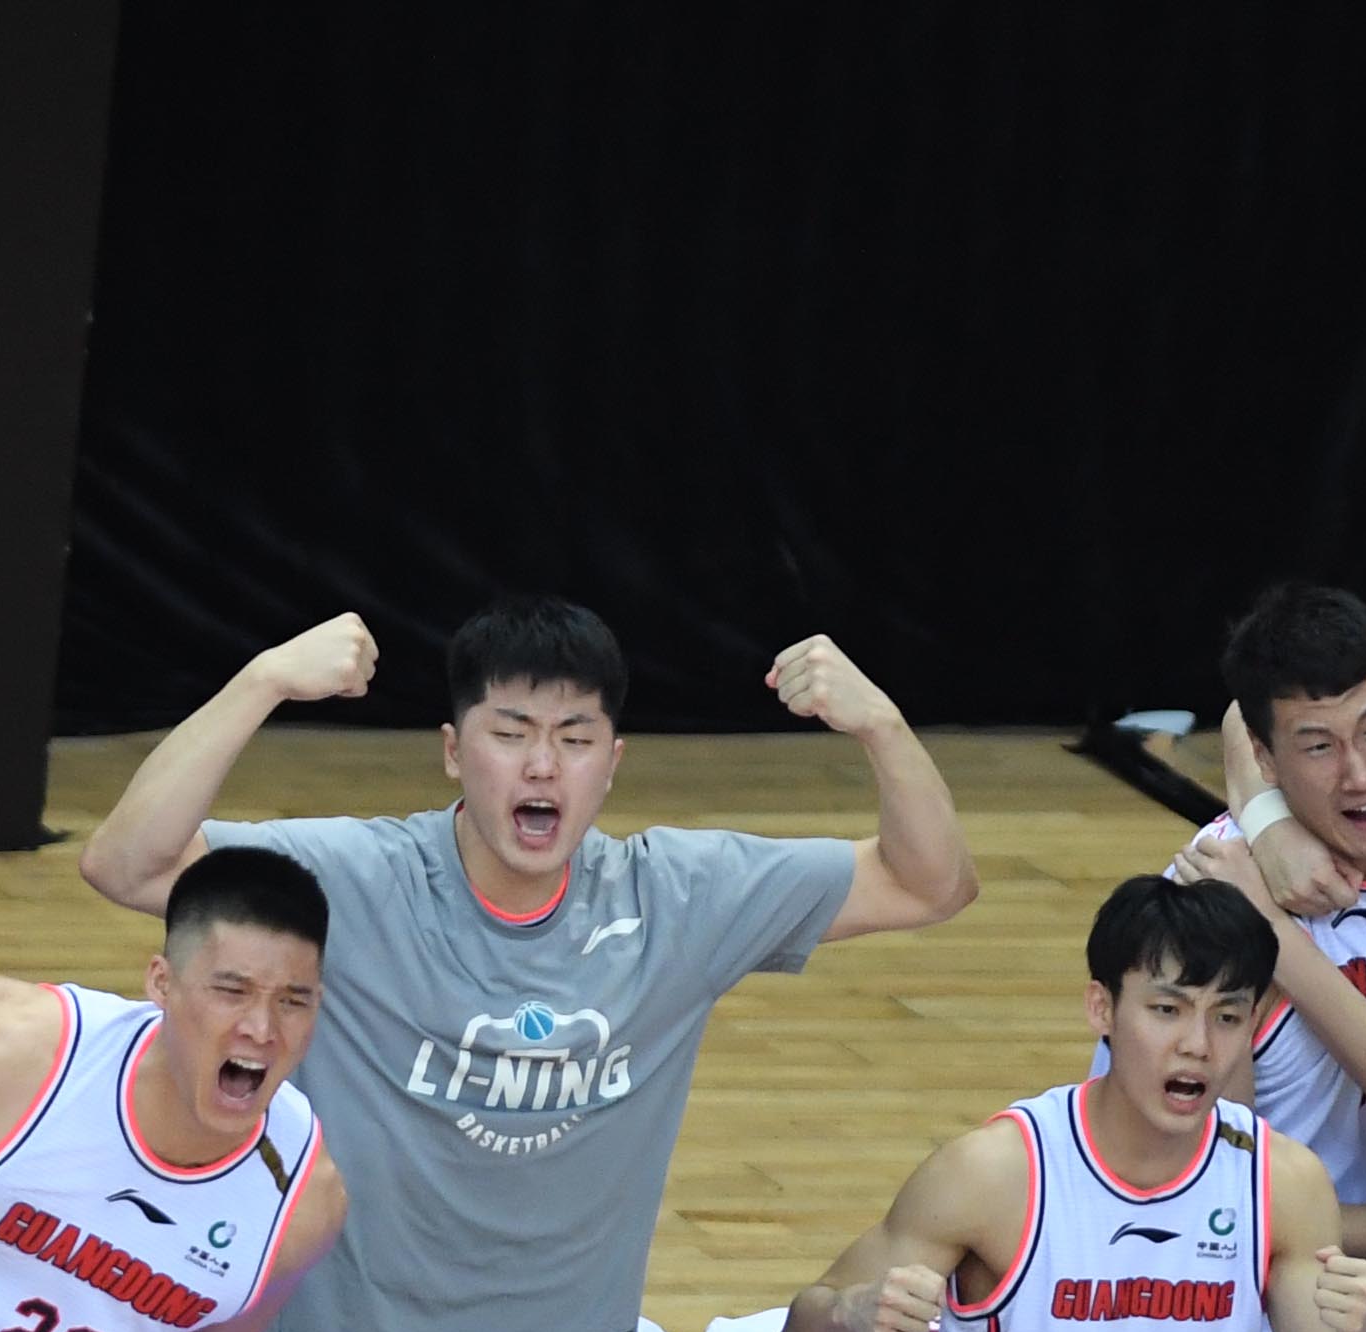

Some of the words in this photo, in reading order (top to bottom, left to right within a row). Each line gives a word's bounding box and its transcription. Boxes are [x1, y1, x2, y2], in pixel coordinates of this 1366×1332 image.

[407, 1039, 632, 1110] LI-NING
[456, 1112, 583, 1155] BASKETBALL
[1051, 1277, 1235, 1322] GUANGDONG
